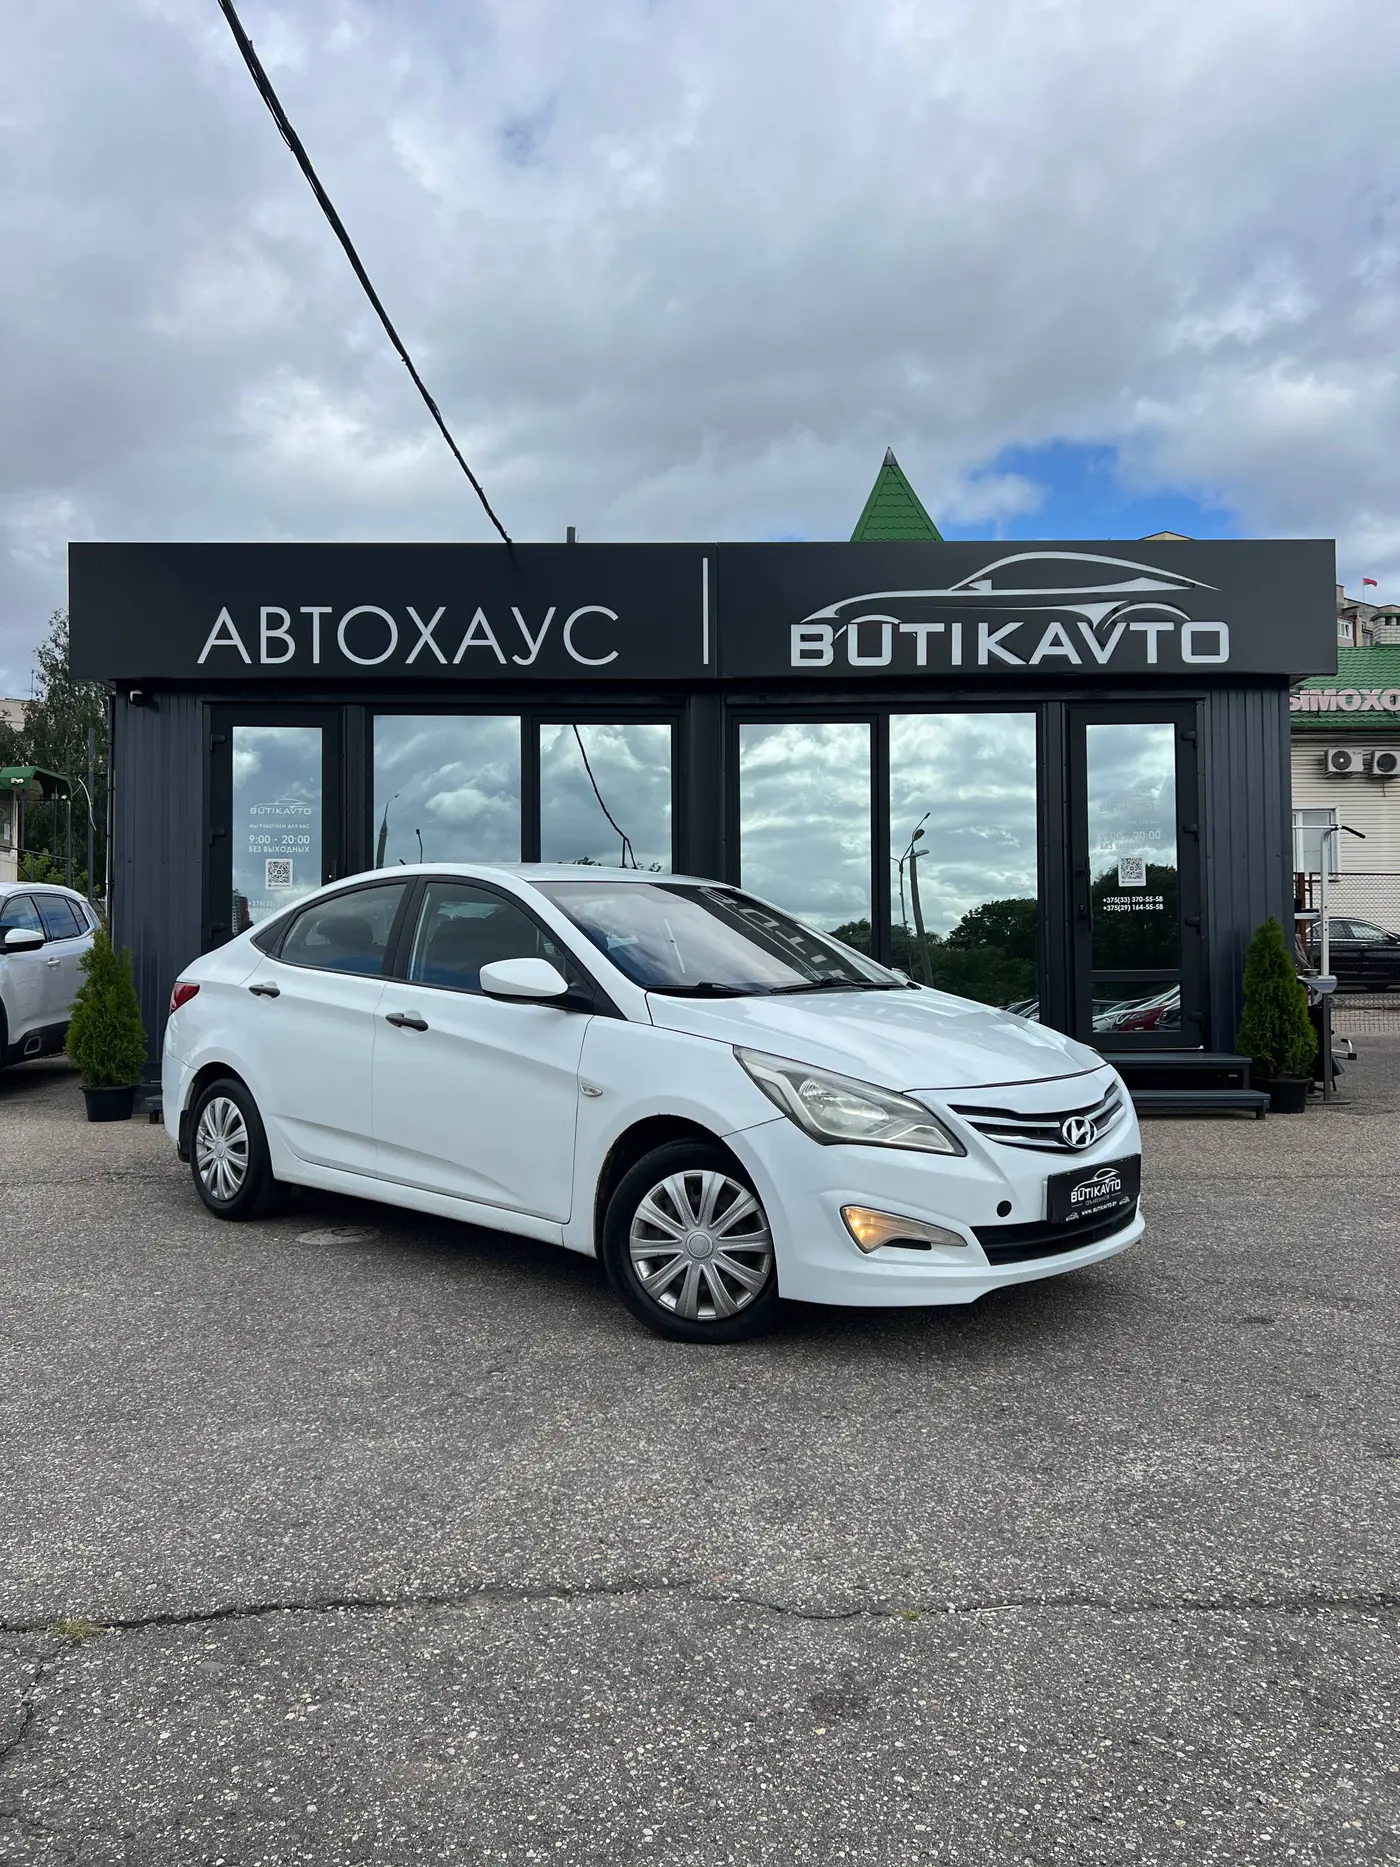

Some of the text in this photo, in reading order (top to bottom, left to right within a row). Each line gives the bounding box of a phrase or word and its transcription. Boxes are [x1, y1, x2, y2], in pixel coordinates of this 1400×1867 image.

[196, 605, 621, 667] АВТОХАУС
[790, 620, 1230, 667] BUTIKAVTO
[250, 807, 312, 815] BUTIKAVTO
[249, 834, 271, 844] 9:00
[281, 834, 310, 844] 20:00
[249, 845, 310, 853] БЕЗ ВЫХОДНЫХ
[1102, 895, 1164, 904] +375(33) 370-55-58
[1103, 904, 1131, 912] +375(29)
[1070, 1179, 1121, 1203] BUTIKAVTO
